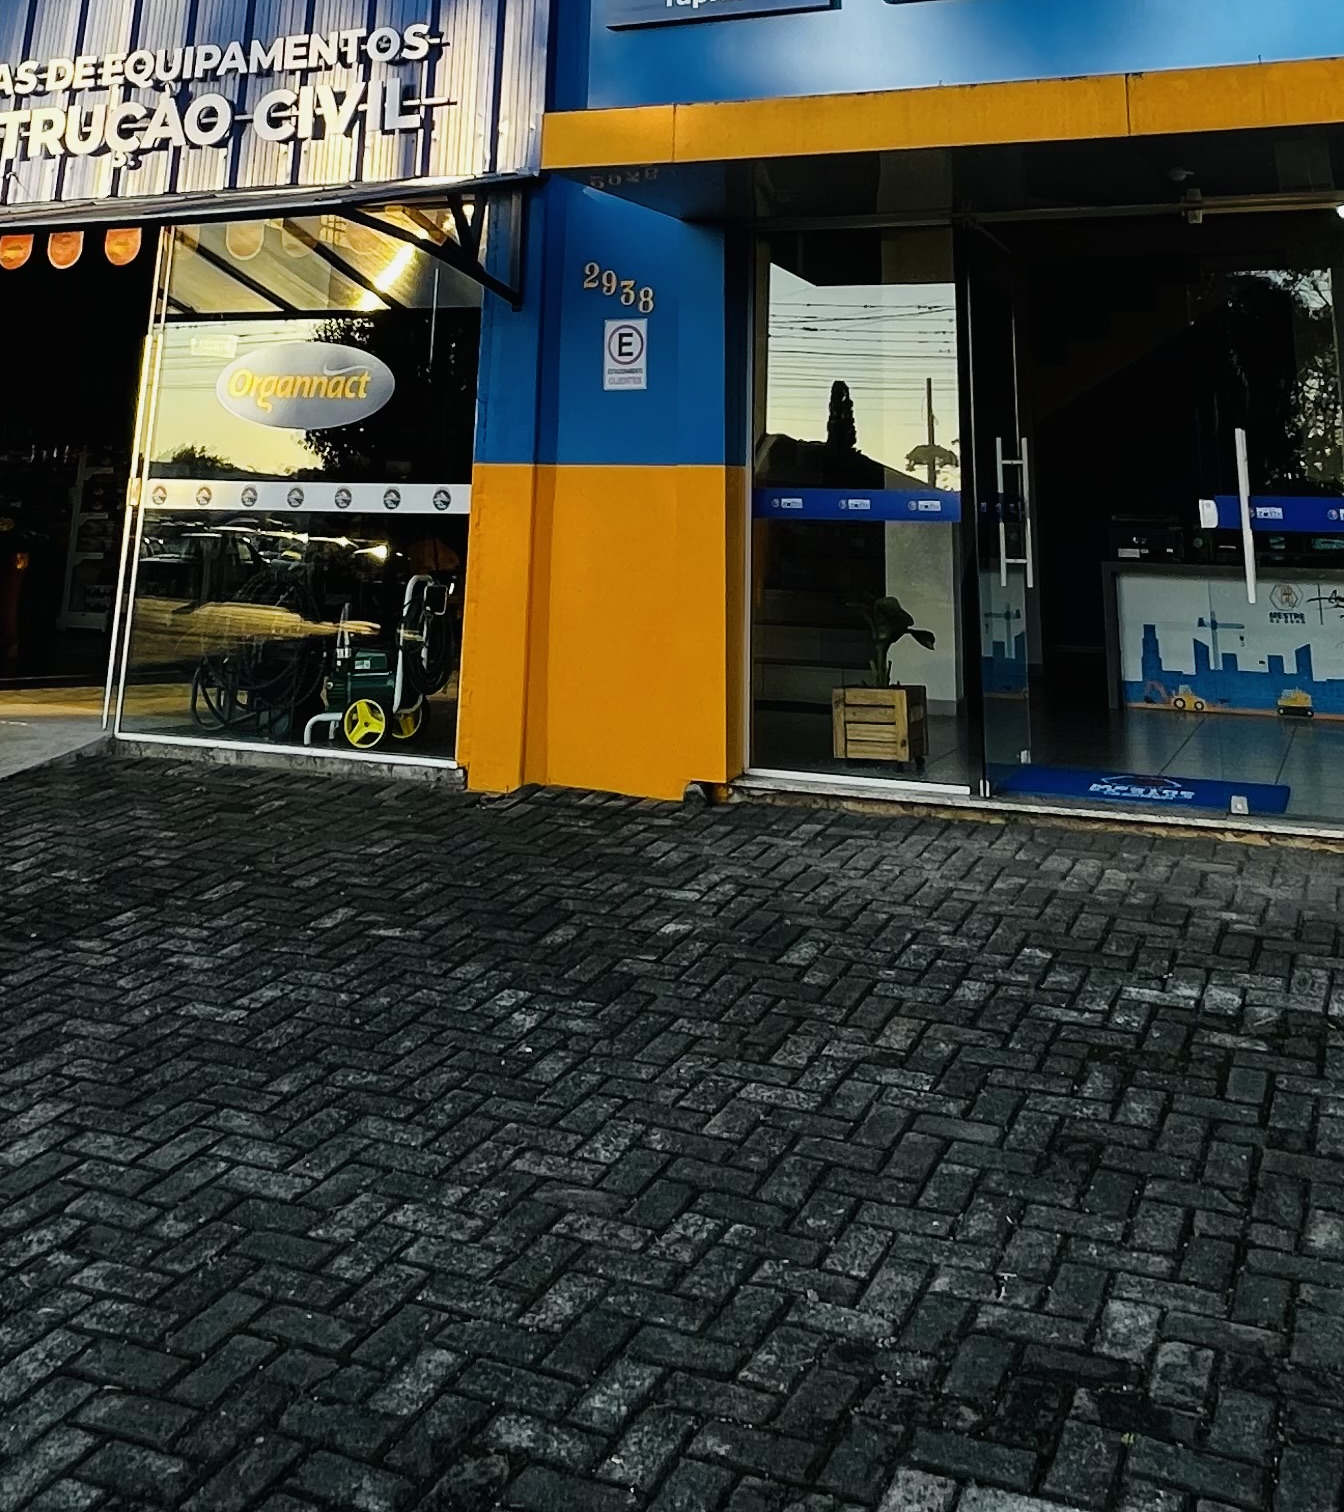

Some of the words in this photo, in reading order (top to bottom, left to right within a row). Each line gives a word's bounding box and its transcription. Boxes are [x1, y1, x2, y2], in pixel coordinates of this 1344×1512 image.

[46, 54, 98, 91] DE
[100, 22, 433, 88] EQUIPAMENTOS
[253, 77, 421, 142] CIVIL
[583, 262, 655, 314] 2938
[617, 332, 634, 357] E
[227, 367, 372, 415] Organnact
